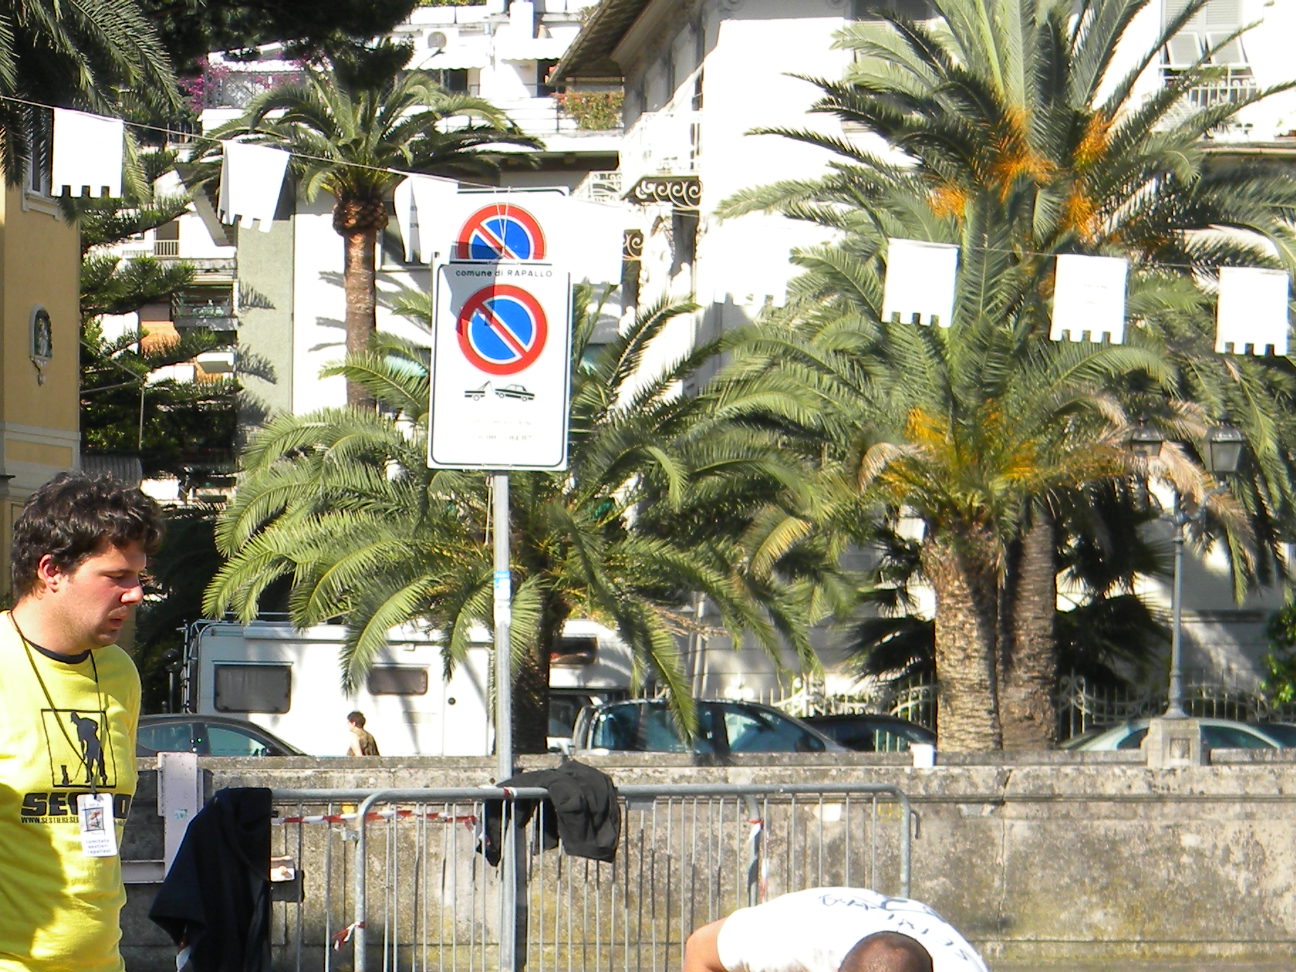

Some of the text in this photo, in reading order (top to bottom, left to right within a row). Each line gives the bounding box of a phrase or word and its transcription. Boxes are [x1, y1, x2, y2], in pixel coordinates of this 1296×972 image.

[455, 269, 553, 278] comune di RAPALLO
